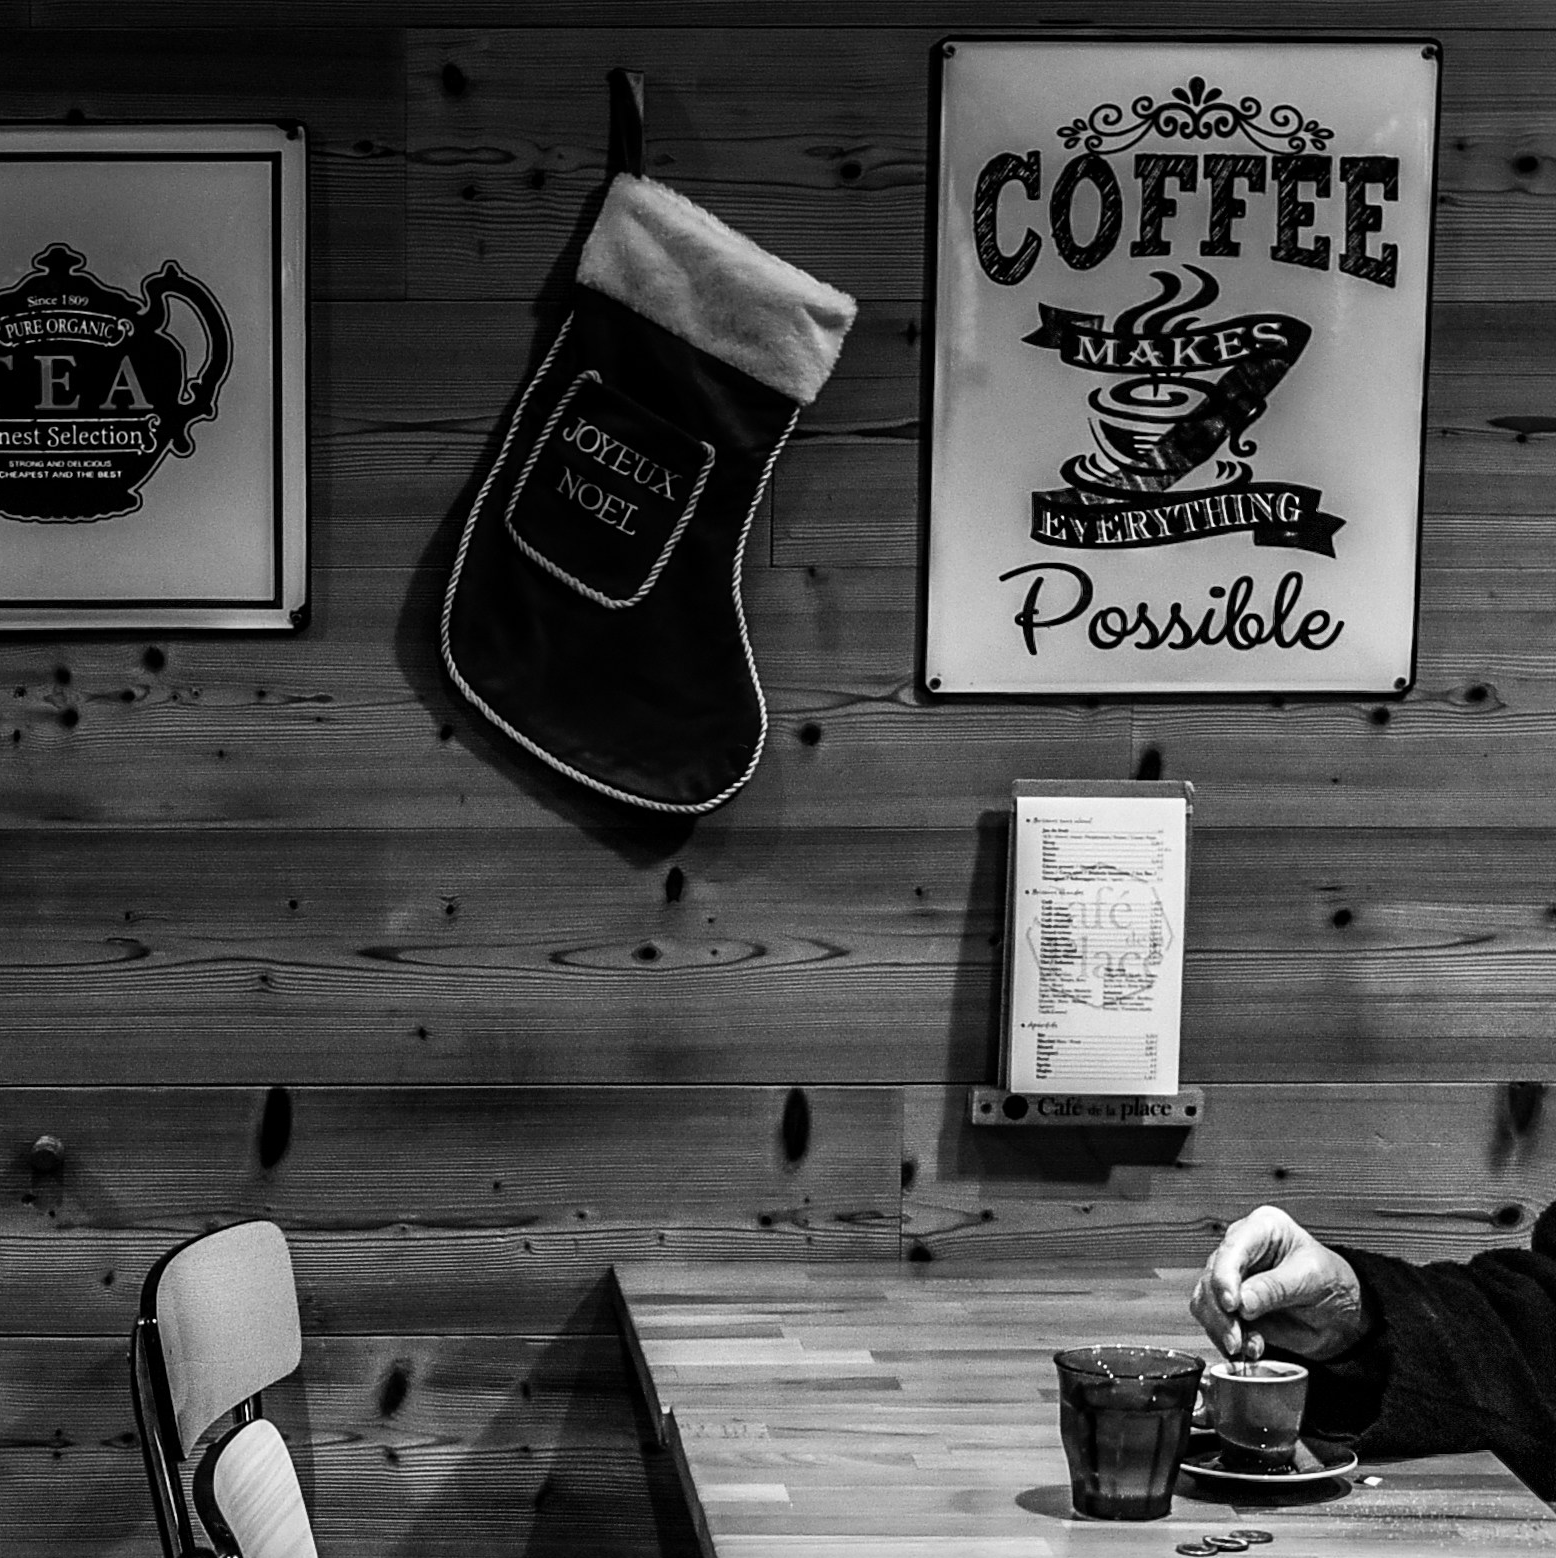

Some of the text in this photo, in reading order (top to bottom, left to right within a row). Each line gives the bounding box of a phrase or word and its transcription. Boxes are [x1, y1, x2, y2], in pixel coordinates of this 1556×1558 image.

[972, 150, 1401, 290] COFFEE
[26, 294, 90, 308] Since 1809
[5, 317, 115, 339] PURE ORGANIC
[1073, 321, 1289, 369] MAKES
[46, 424, 144, 448] Selection
[8, 459, 112, 468] STRONG AND DELICIOUS
[51, 470, 74, 479] AND
[76, 470, 95, 479] THE
[97, 470, 123, 479] BEST
[561, 416, 683, 502] JOYEUX
[555, 465, 639, 536] NOEL
[1037, 492, 1302, 544] EVERYTHING
[997, 561, 1346, 656] Possible
[1120, 1096, 1173, 1121] place
